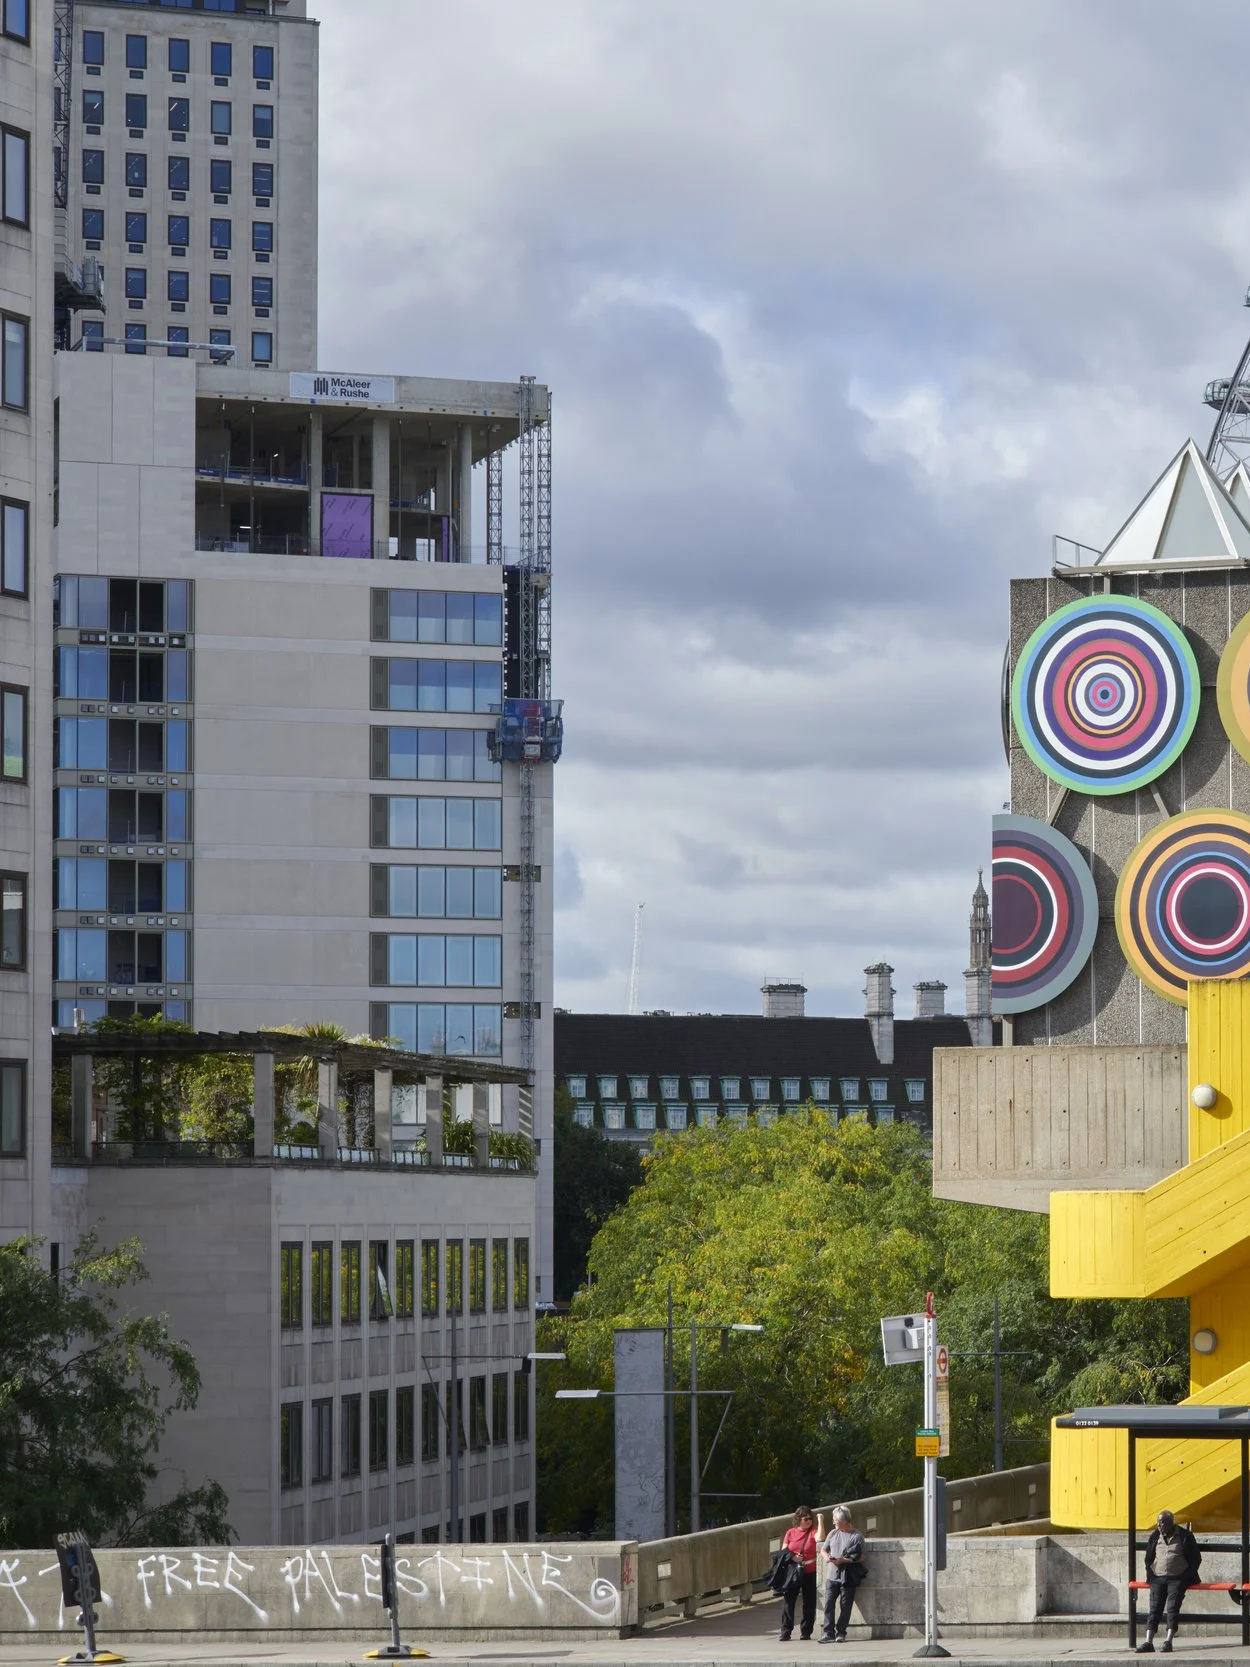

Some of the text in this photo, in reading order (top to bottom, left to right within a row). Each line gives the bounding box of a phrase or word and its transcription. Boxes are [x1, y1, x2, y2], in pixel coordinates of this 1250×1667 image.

[331, 378, 371, 389] McAleer
[331, 388, 369, 398] & Rushe
[137, 1551, 269, 1624] FREE
[280, 1549, 621, 1621] PALESTINE
